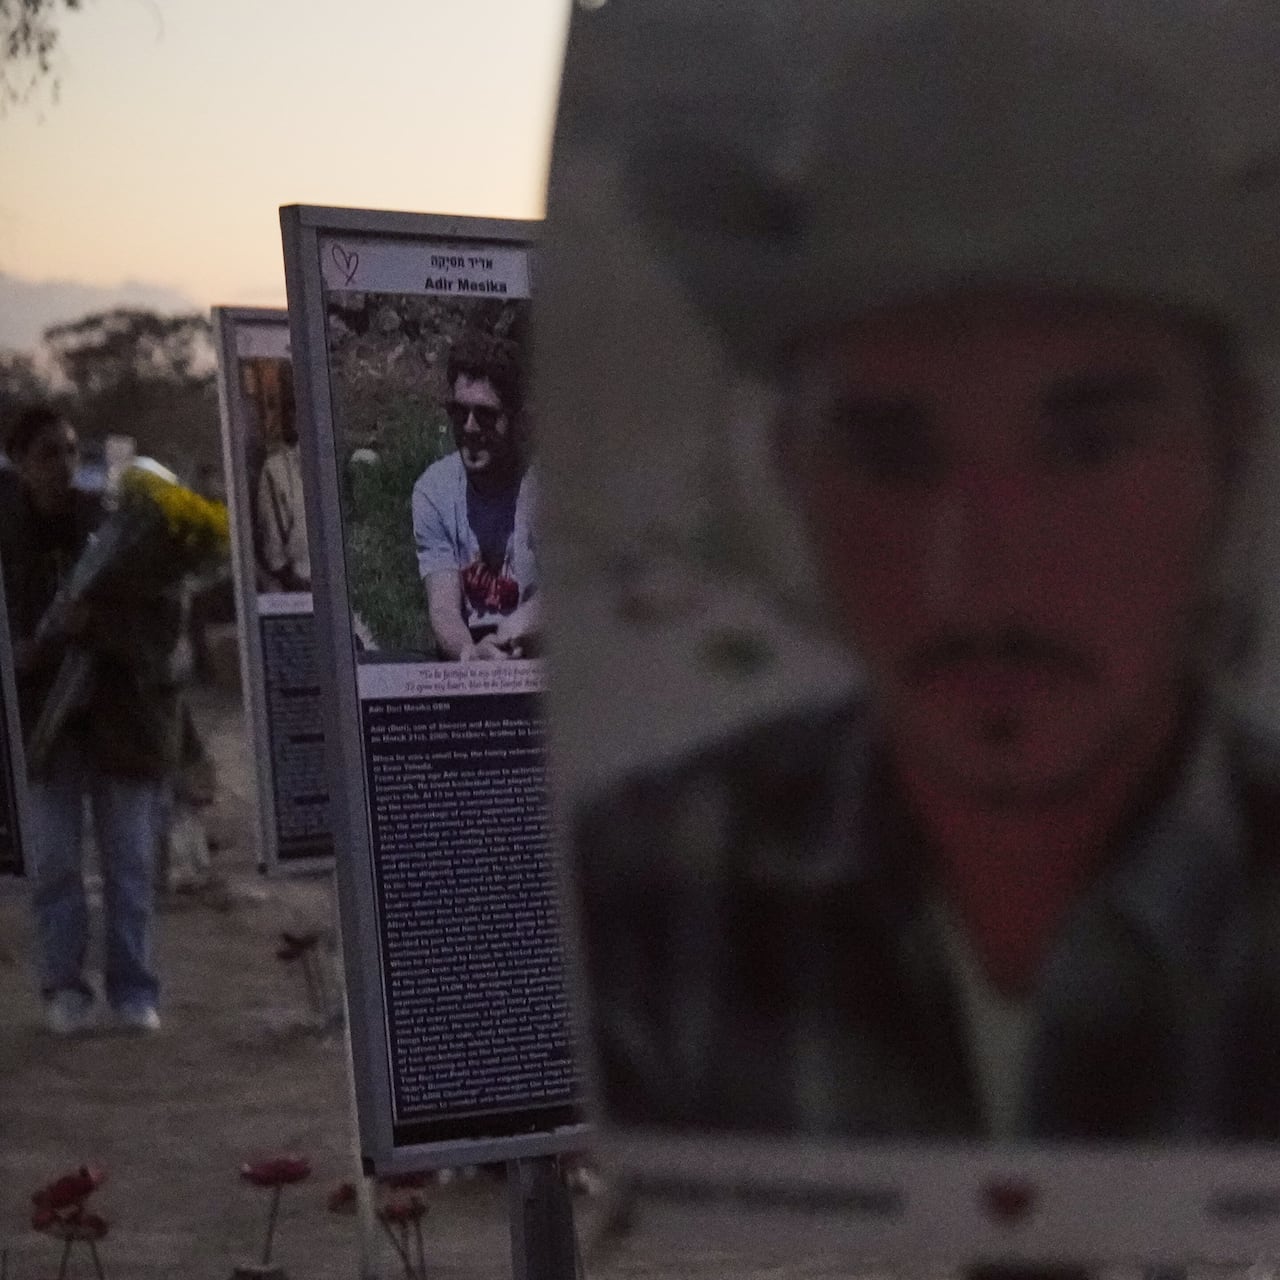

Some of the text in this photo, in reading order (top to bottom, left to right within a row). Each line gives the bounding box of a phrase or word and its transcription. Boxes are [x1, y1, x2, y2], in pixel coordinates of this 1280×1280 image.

[430, 255, 493, 271] אדיר מסיקה
[425, 278, 453, 291] Adir
